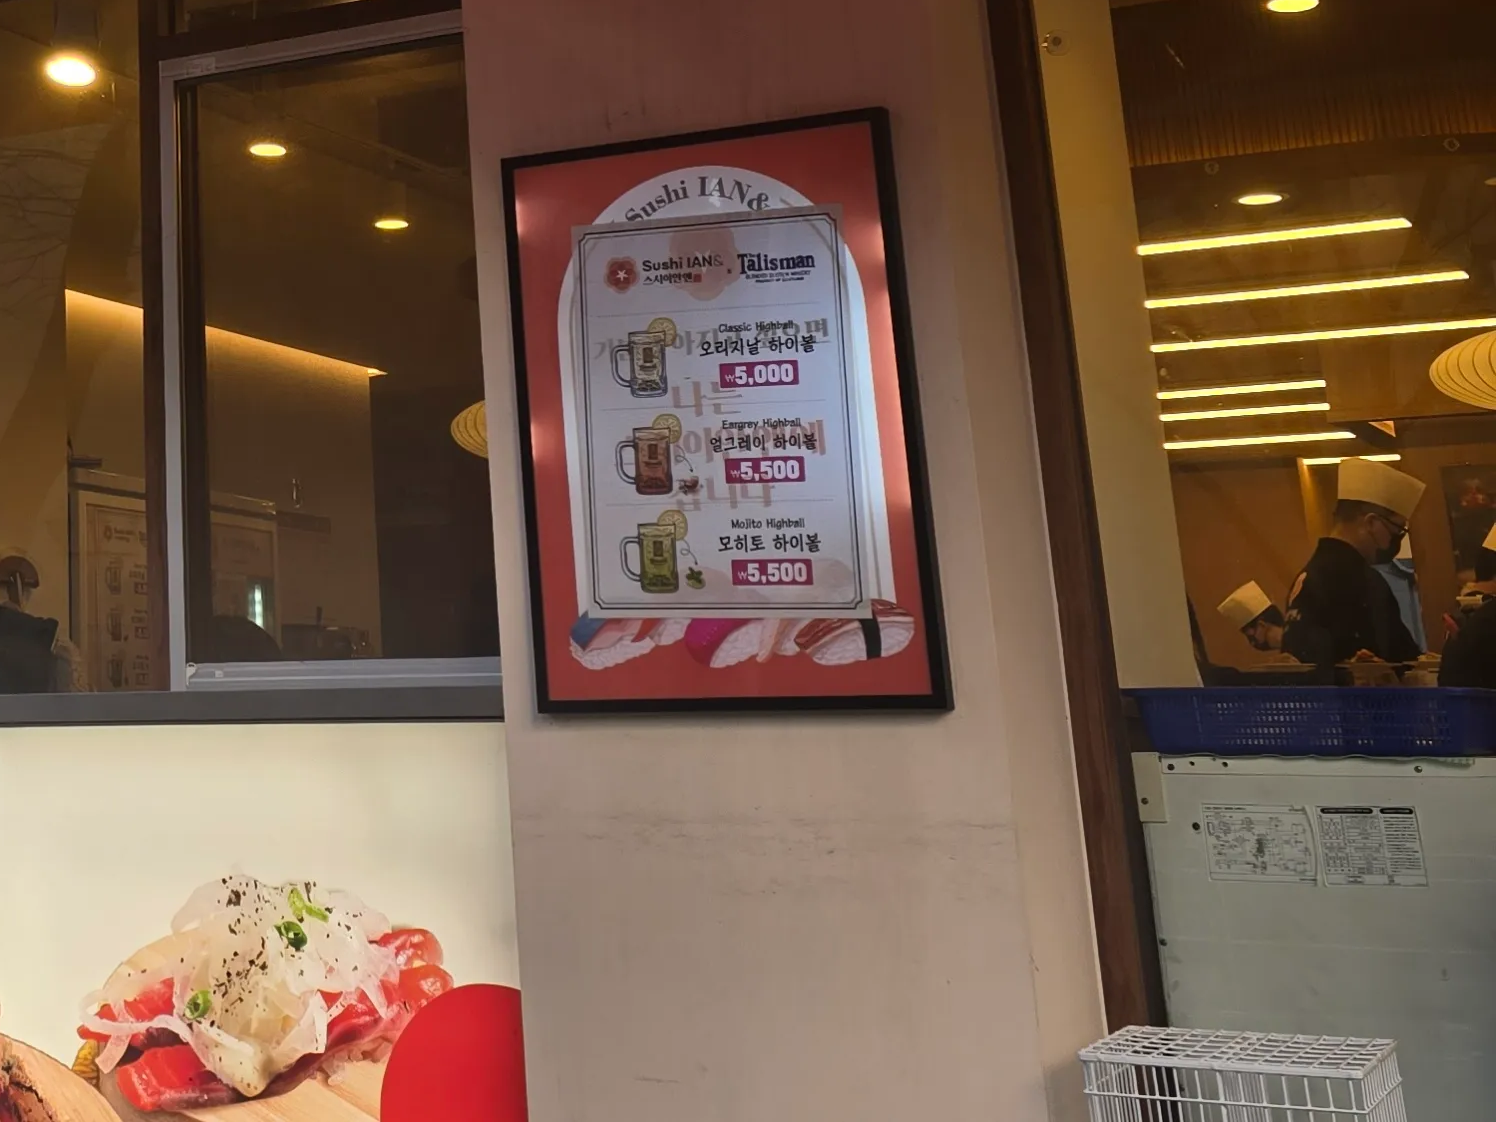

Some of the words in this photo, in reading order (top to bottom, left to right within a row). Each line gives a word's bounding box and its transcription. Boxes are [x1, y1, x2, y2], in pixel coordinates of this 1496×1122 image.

[625, 179, 689, 220] Sushi
[641, 256, 683, 272] Sushi
[687, 254, 724, 269] IAN&
[736, 252, 816, 275] Talisman
[718, 322, 752, 334] Classic
[755, 319, 794, 333] Highball
[699, 337, 762, 357] 오리지날
[769, 334, 817, 355] 하이볼
[721, 419, 759, 432] Eargrey
[762, 417, 802, 430] Highball
[709, 434, 766, 453] 얼그레이
[773, 431, 818, 451] 하이볼
[731, 519, 763, 531] Mojito
[765, 518, 805, 532] Highball
[717, 534, 766, 553] 모히토
[772, 533, 822, 553] 하이볼
